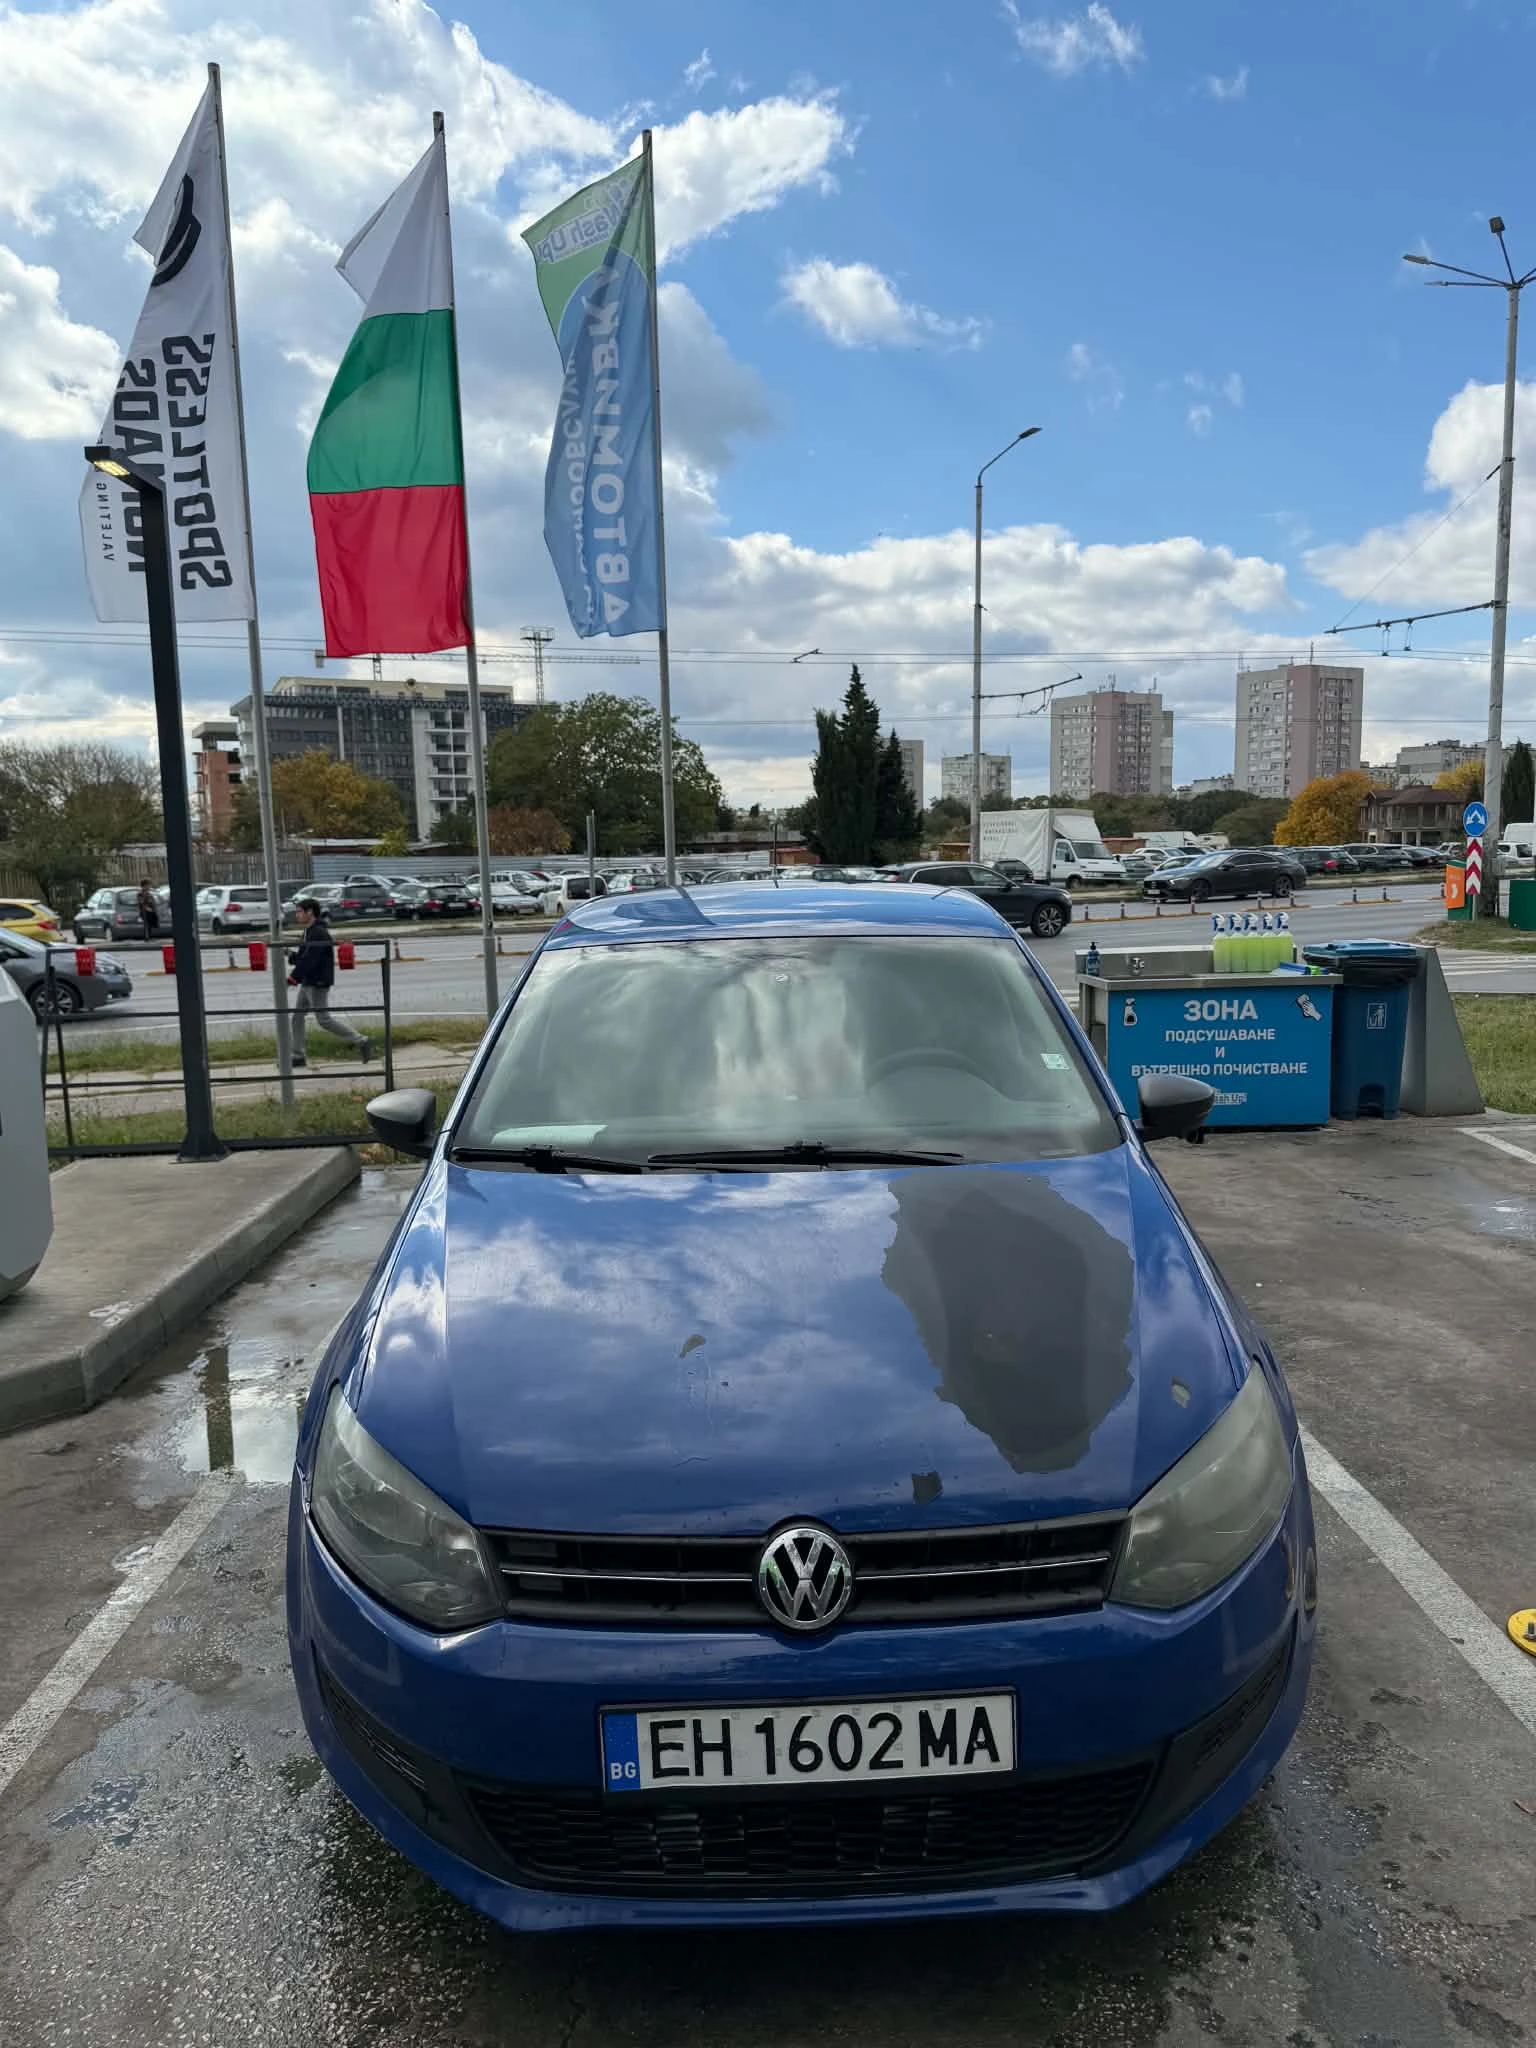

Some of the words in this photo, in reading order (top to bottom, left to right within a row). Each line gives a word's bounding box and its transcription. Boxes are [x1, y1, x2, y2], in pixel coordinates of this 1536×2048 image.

[1183, 999, 1259, 1022] ЗОНА
[1165, 1028, 1276, 1044] ПОДСУШАВАНЕ
[1215, 1046, 1226, 1059] И
[1131, 1063, 1210, 1077] ВЪТРЕШНО
[1213, 1062, 1308, 1076] ПОЧИСТВАНЕ
[649, 1716, 734, 1779] EH
[754, 1711, 904, 1773] 1602
[919, 1706, 1001, 1768] MA
[610, 1761, 637, 1781] BG
